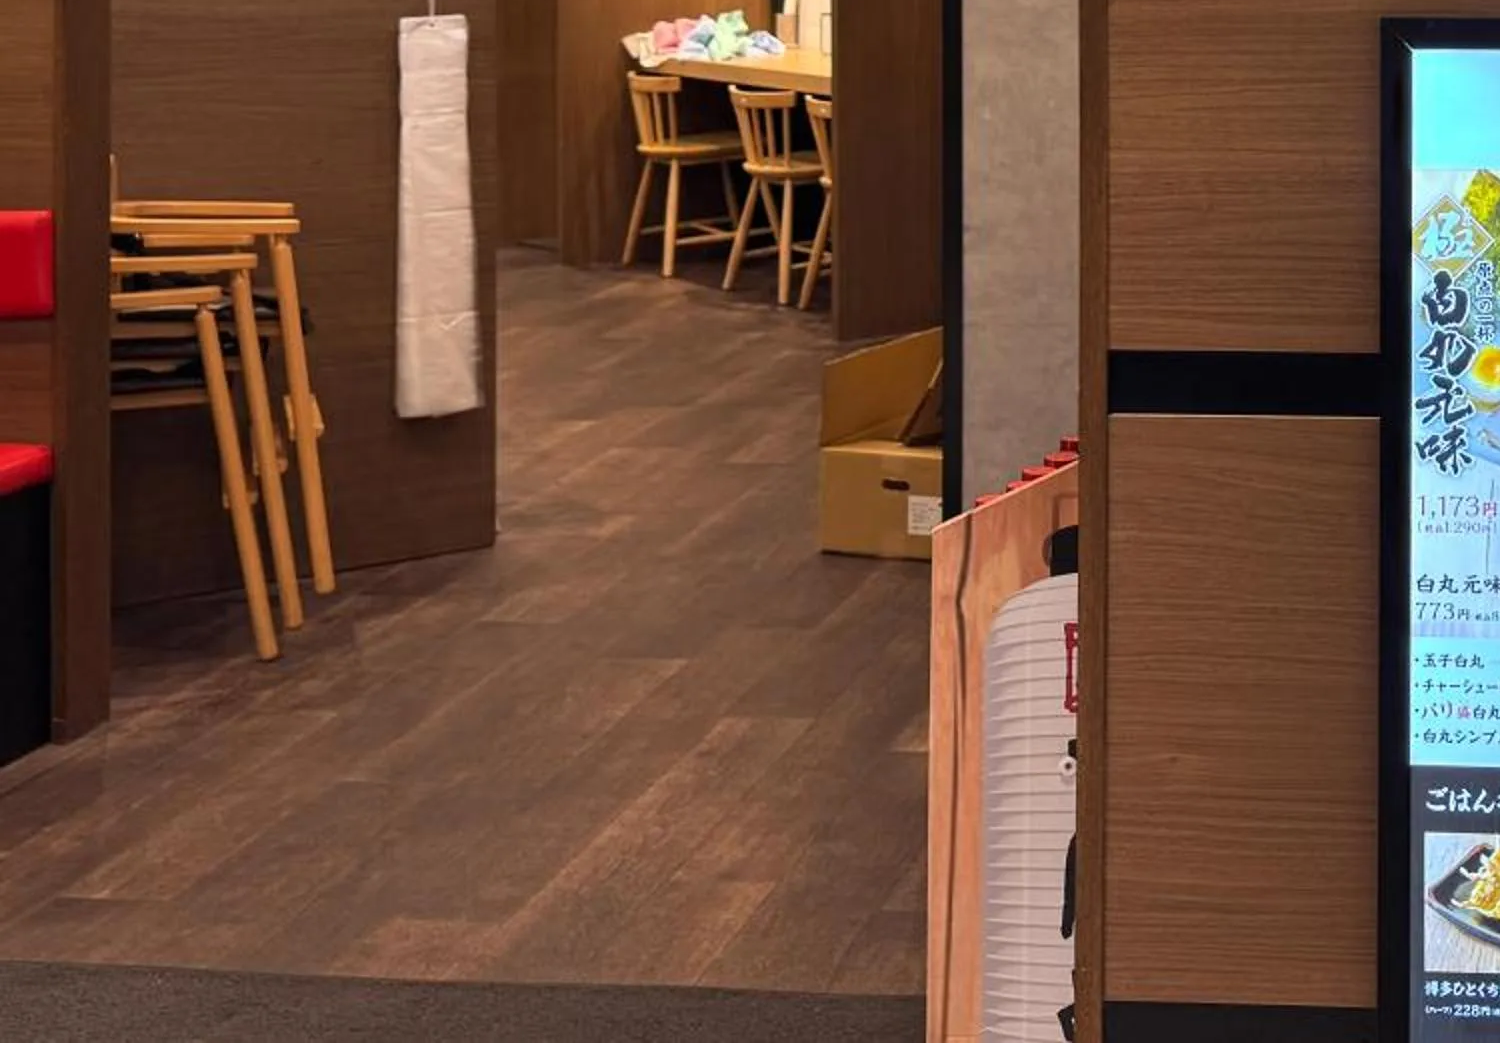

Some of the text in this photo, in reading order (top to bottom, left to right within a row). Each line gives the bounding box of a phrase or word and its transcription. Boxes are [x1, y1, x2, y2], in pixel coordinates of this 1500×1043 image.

[1417, 495, 1497, 520] 1,173円
[1415, 602, 1470, 622] 773円
[1423, 653, 1485, 669] 玉子白丸
